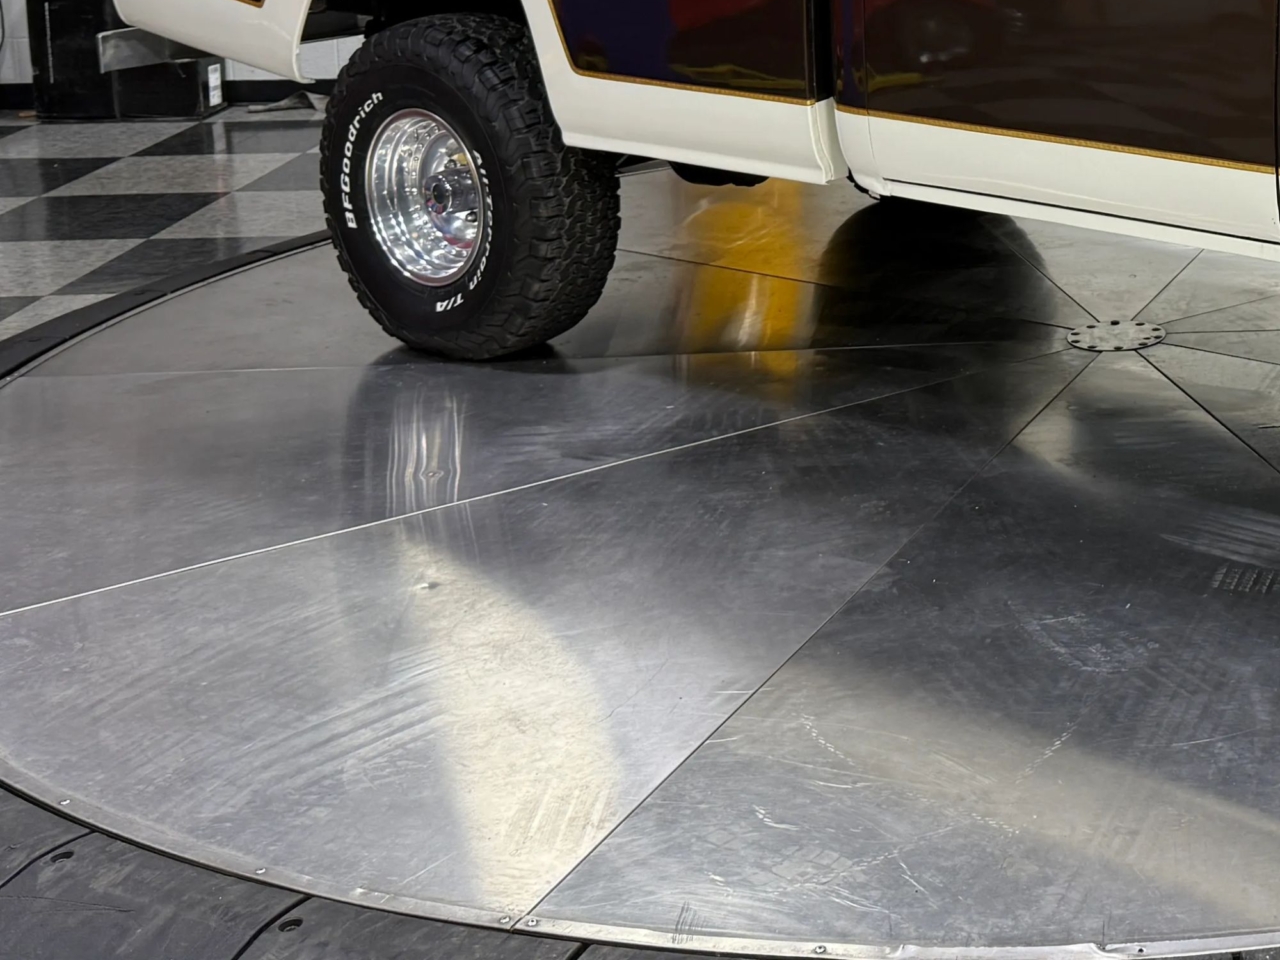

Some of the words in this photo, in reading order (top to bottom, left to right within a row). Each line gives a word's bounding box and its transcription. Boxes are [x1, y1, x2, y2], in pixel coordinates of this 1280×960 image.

[340, 91, 384, 229] BFGoodrich
[469, 149, 494, 290] All-Terrain
[435, 291, 464, 313] T/A
